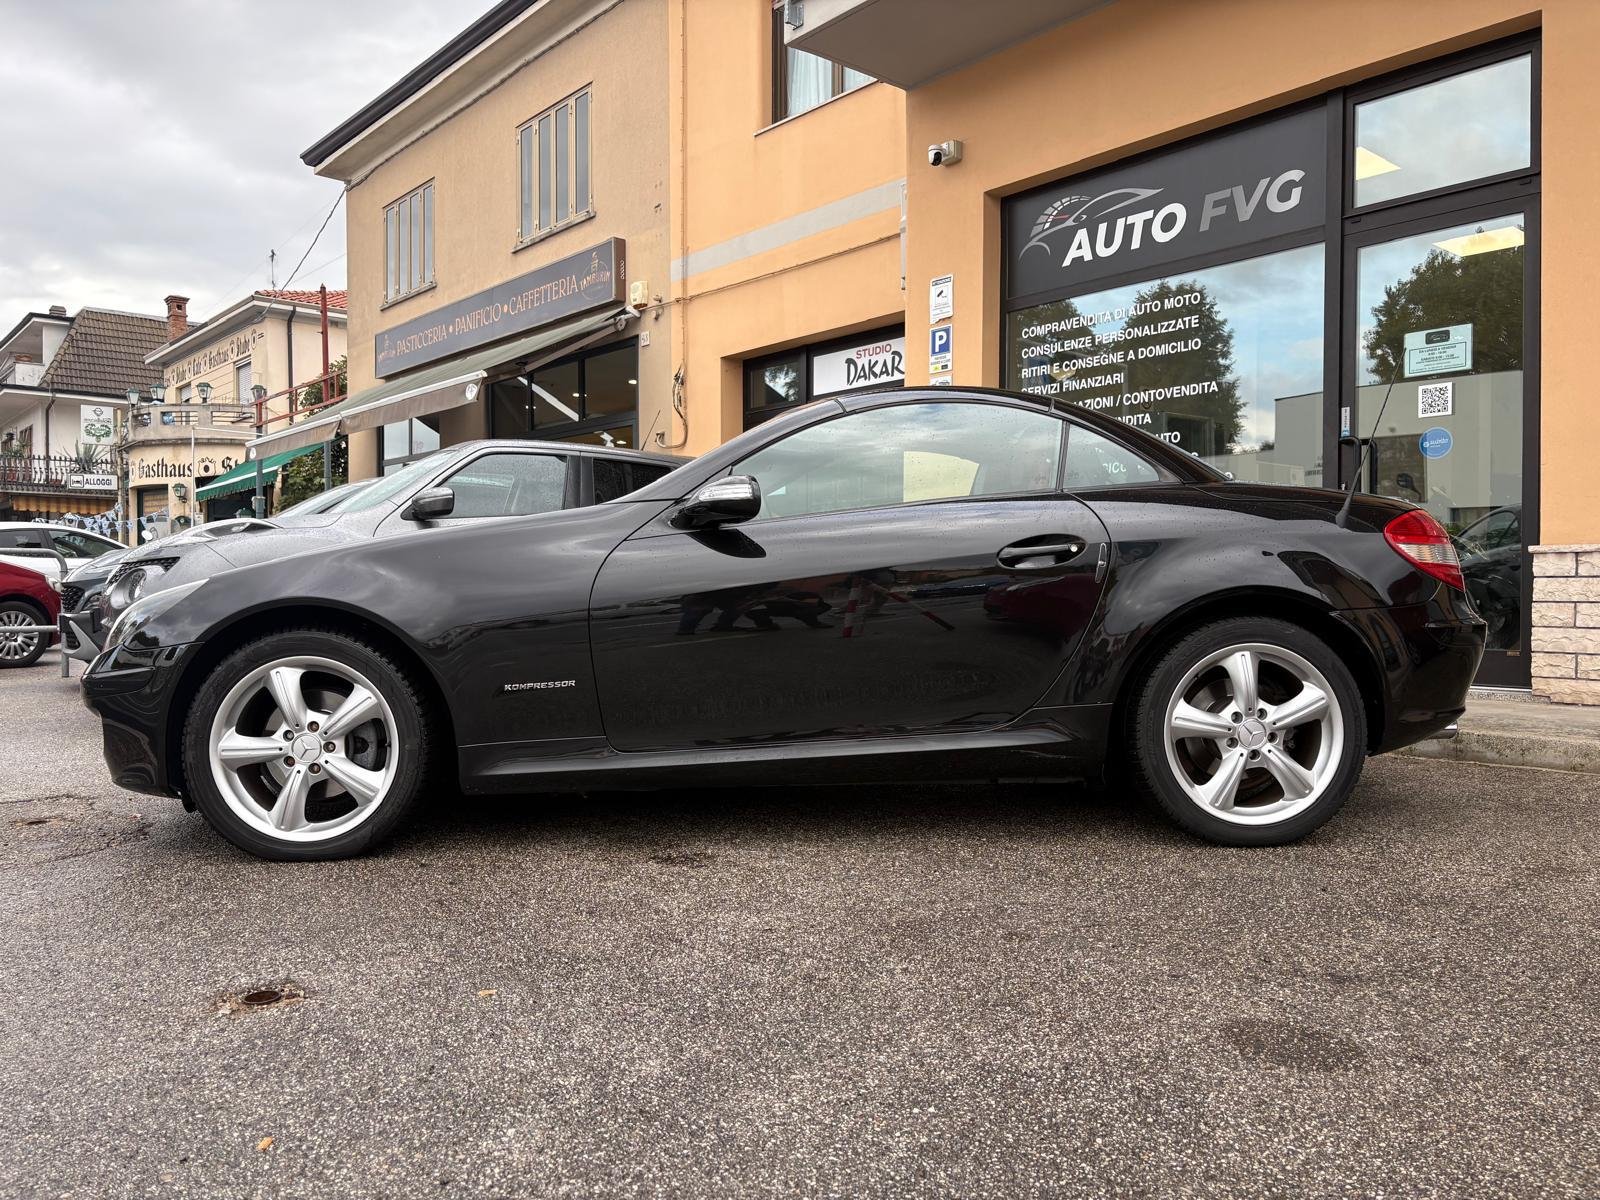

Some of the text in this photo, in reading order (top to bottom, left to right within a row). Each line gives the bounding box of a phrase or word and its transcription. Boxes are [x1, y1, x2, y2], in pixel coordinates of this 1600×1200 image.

[1062, 169, 1306, 268] AUTO FVG
[396, 275, 579, 356] PASTICCERIA PANIFICIO CAFFETTERIA
[1022, 292, 1201, 339] COMPRAVENDITA DI AUTO MOTO
[935, 331, 947, 352] P
[1022, 315, 1200, 359] CONSULENZE PERSONALIZZATE
[855, 343, 892, 360] STUDIO
[1022, 338, 1201, 379] RITIRI E CONSEGNE A DOMICILIO
[845, 351, 905, 386] DAKAR
[1063, 373, 1124, 392] FINANZIARI
[1123, 380, 1219, 405] CONTOVENDITA
[138, 454, 192, 480] Gasthaus
[85, 478, 112, 486] ALLOGGI
[504, 680, 576, 691] KOMPRESSOR
